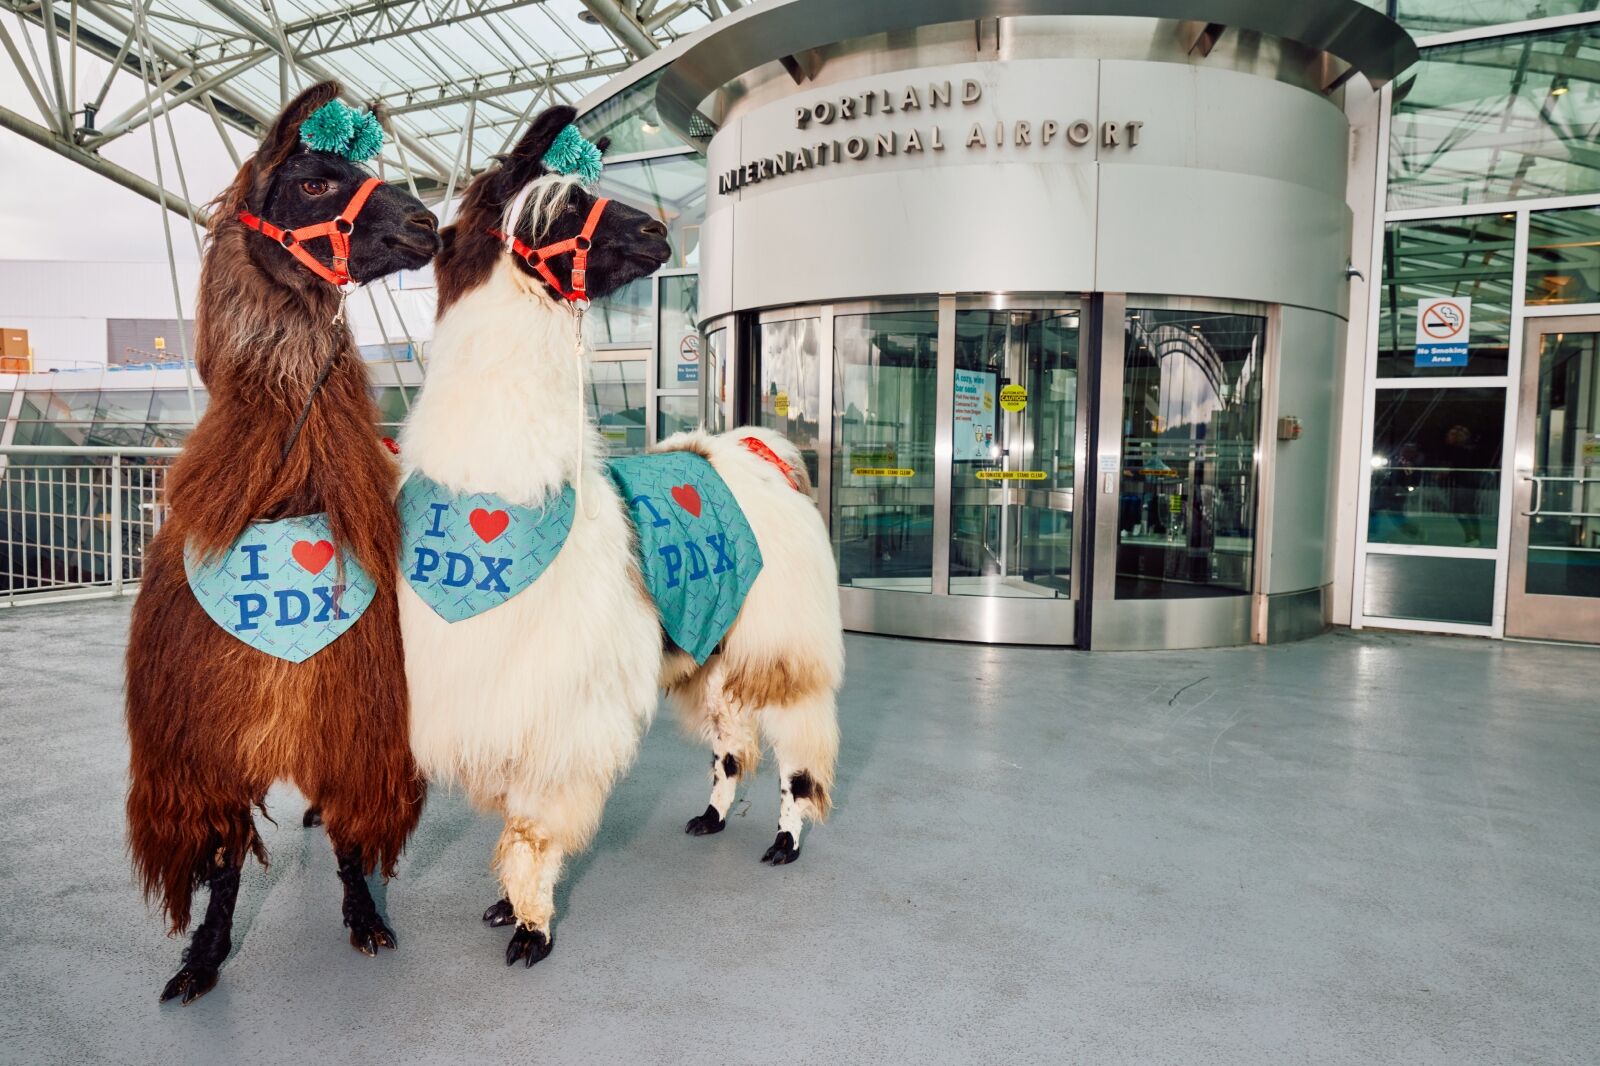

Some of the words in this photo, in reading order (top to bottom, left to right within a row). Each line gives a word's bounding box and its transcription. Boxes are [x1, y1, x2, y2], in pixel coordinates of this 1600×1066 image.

[795, 78, 983, 130] PORTLAND
[966, 119, 1145, 147] AIRPORT
[1431, 347, 1468, 355] Smoking
[1431, 355, 1452, 363] Area
[424, 503, 449, 537] I
[631, 494, 671, 528] I
[241, 544, 270, 581] I
[410, 546, 514, 593] PDX
[659, 533, 735, 590] PDX
[234, 584, 350, 631] PDX
